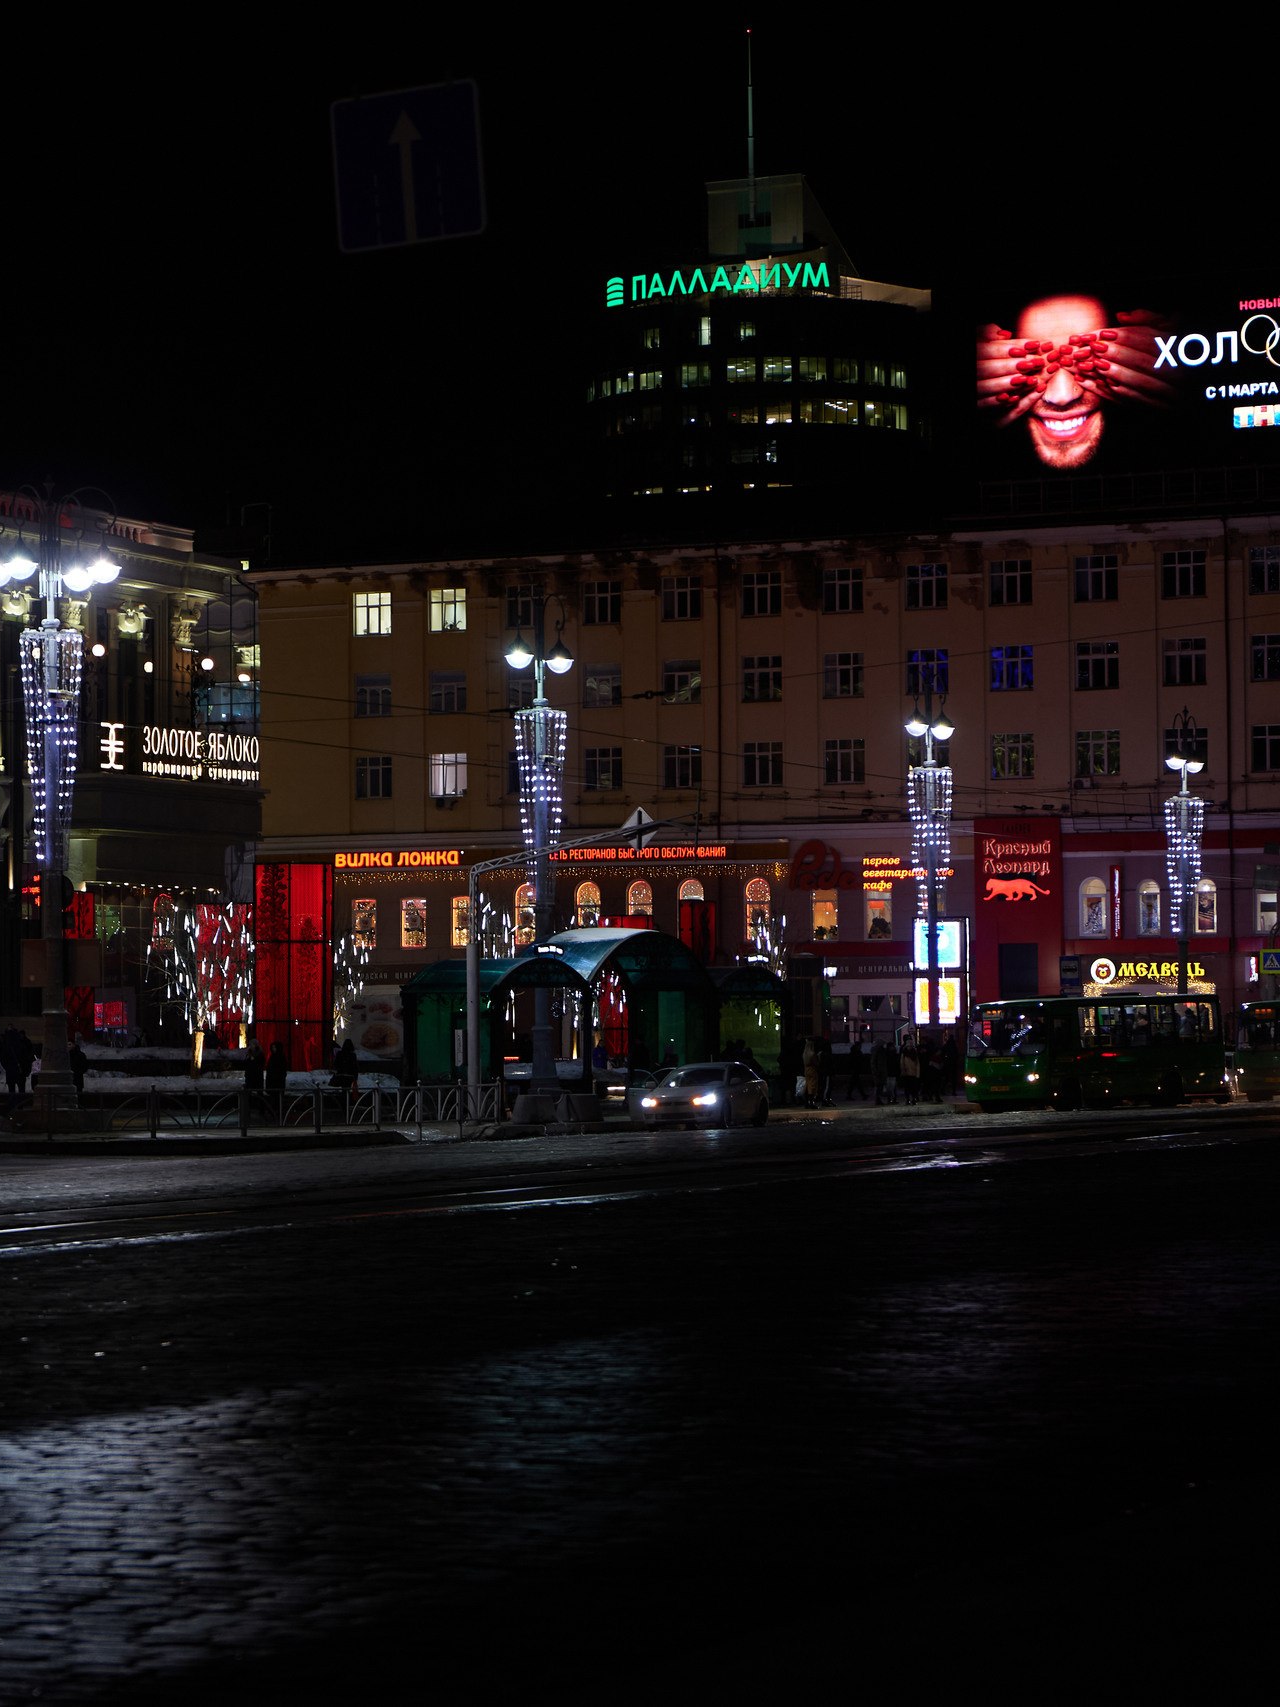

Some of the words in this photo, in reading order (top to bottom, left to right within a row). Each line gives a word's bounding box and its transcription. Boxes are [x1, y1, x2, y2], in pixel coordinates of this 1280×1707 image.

[632, 262, 830, 301] ПАЛЛАДИУМ
[1205, 386, 1216, 399] С
[1218, 385, 1226, 398] 1
[1228, 381, 1279, 398] МАРТА
[142, 725, 202, 759] ЗОЛОТОЕ
[207, 732, 260, 764] ЯБЛОКО
[208, 766, 260, 782] супермаркет
[569, 848, 617, 860] РЕСТОРАНОВ
[983, 839, 1051, 859] Красный
[862, 857, 901, 868] первое
[983, 858, 1051, 877] Леопард
[862, 879, 893, 892] кафе
